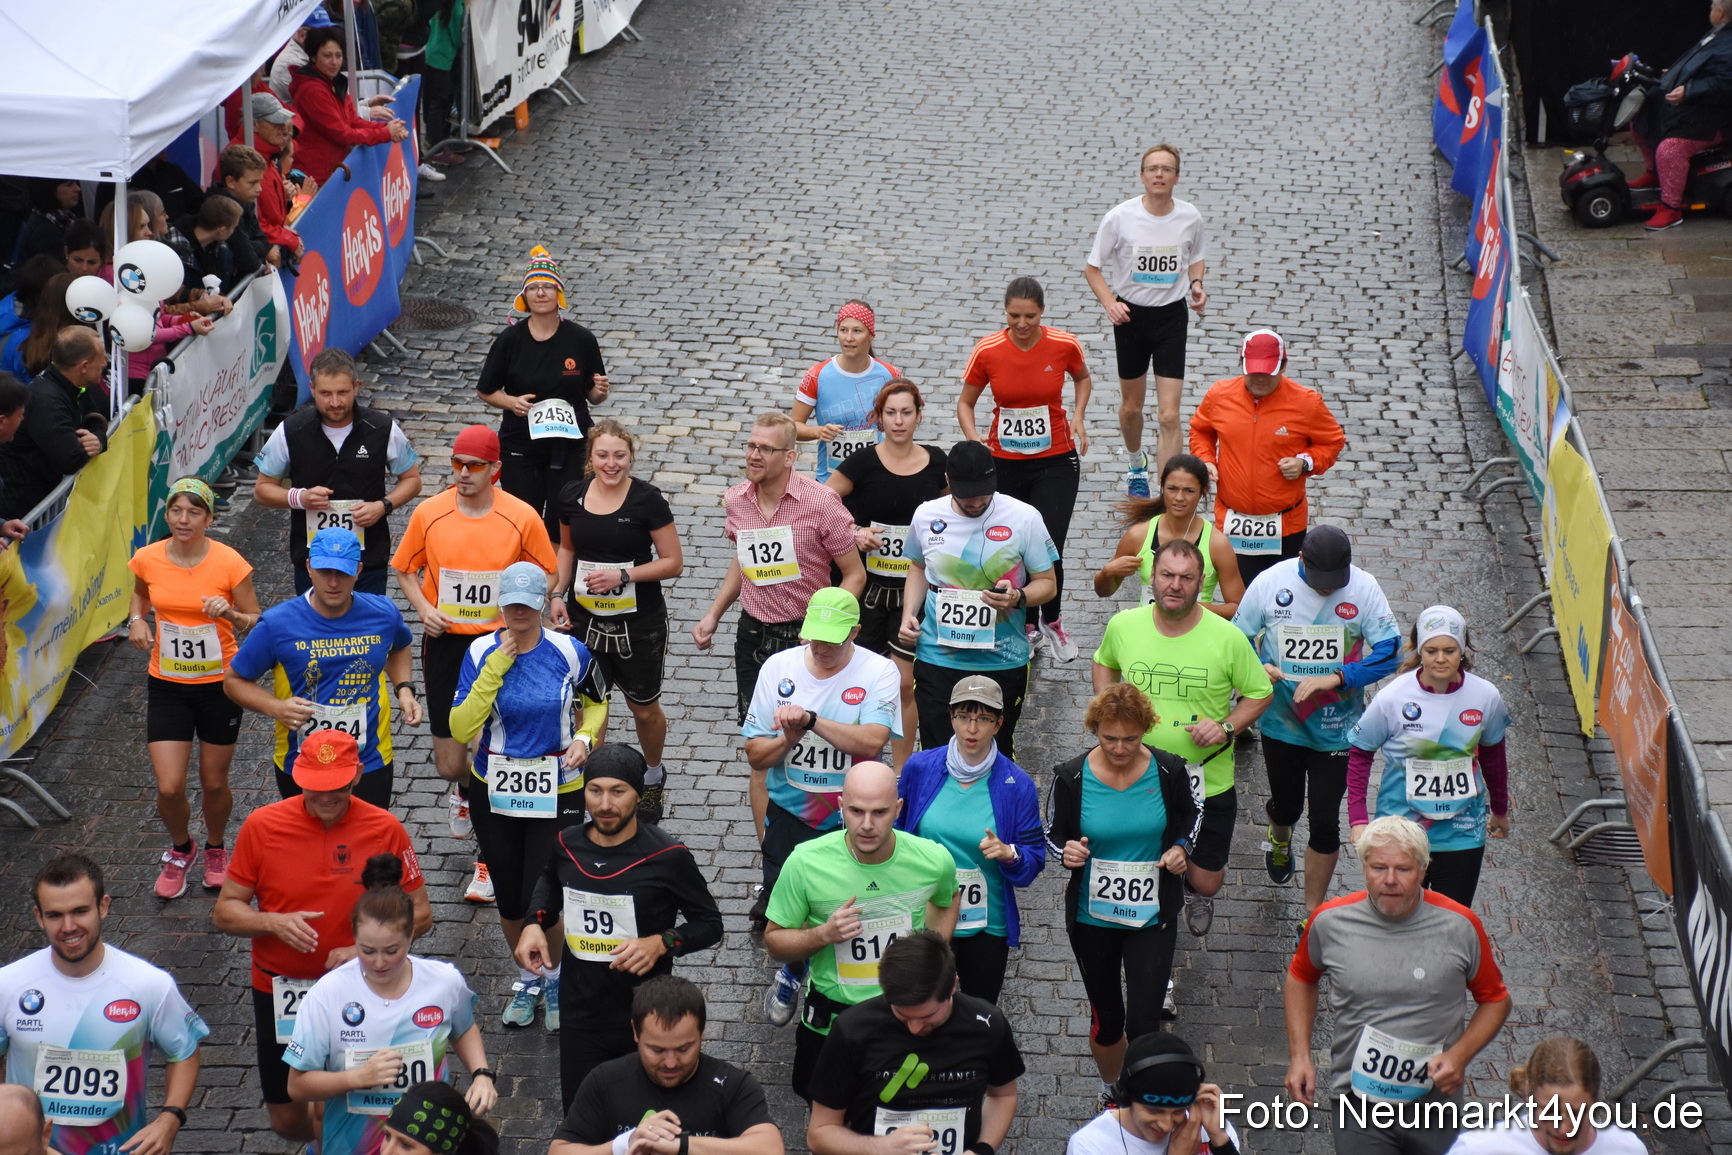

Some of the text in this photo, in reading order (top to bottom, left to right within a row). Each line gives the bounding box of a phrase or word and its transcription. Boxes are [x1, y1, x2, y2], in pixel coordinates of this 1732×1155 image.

[382, 159, 412, 226] Hervis
[342, 209, 382, 284] Hervis
[1137, 255, 1178, 272] 3065
[293, 272, 330, 355] Hervis
[533, 407, 574, 425] 2453
[544, 424, 569, 433] Sandra
[1003, 417, 1046, 437] 2483
[1010, 440, 1040, 448] Christina
[317, 512, 353, 532] 285
[1229, 518, 1277, 537] 2626
[989, 529, 1009, 538] Hervis
[1241, 540, 1264, 549] Dieter
[748, 541, 784, 564] 132
[756, 567, 782, 578] Martin
[452, 583, 491, 604] 140
[961, 592, 982, 600] BOC
[594, 600, 616, 609] Karin
[458, 608, 482, 617] Horst
[941, 602, 991, 627] 2520
[951, 630, 976, 642] Ronny
[1306, 626, 1338, 635] BOCK
[171, 638, 206, 659] 131
[295, 635, 381, 651] 10. NEUMARKTER
[1285, 638, 1339, 660] 2225
[309, 645, 370, 658] STADTLAUF
[174, 662, 206, 671] Claudia
[1292, 664, 1330, 674] Christian
[1128, 661, 1208, 697] OPF
[845, 691, 864, 701] Hervis
[1322, 706, 1337, 716] 17.
[1463, 712, 1482, 722] Hervis
[791, 742, 846, 770] 2410
[495, 770, 552, 794] 2365
[803, 774, 828, 784] Erwin
[1414, 772, 1470, 797] 2449
[510, 799, 534, 809] Petra
[1435, 803, 1450, 812] Iris
[1123, 864, 1155, 873] BOCK
[1097, 875, 1154, 902] 2362
[590, 895, 627, 907] BOCK
[1112, 906, 1137, 918] Anita
[583, 908, 614, 936] 59
[868, 916, 905, 931] BOCK
[108, 1005, 137, 1017] Hervis
[416, 1011, 441, 1023] Hervis
[16, 1019, 43, 1027] PARTL
[340, 1030, 366, 1038] PARTL
[392, 1043, 425, 1056] OCK
[77, 1051, 121, 1063] BOCK
[1362, 1048, 1429, 1084] 3084
[44, 1065, 120, 1097] 2093
[1366, 1081, 1403, 1095] Stephan
[47, 1101, 108, 1116] Alexander
[916, 1111, 959, 1122] BOCK
